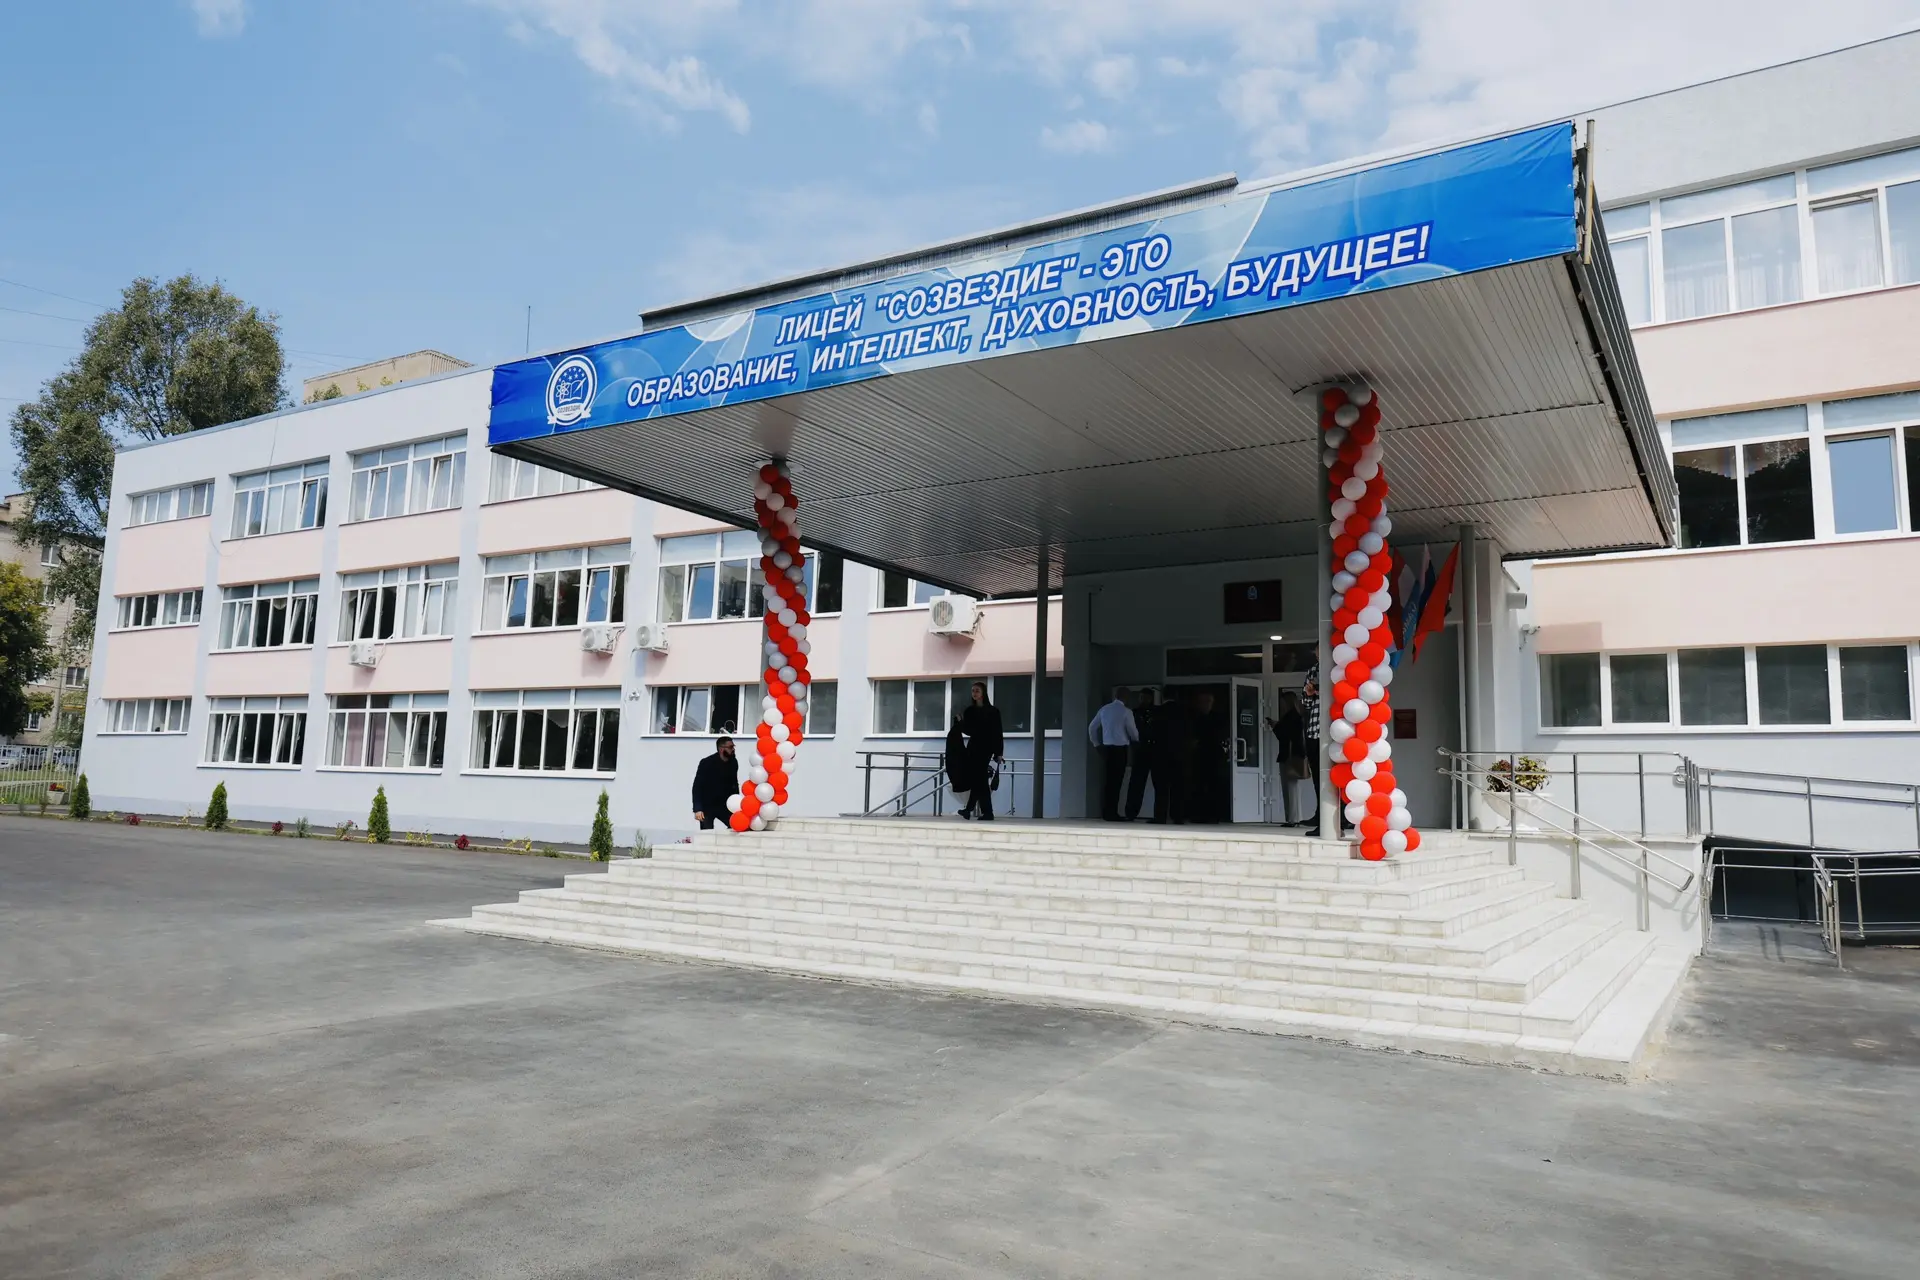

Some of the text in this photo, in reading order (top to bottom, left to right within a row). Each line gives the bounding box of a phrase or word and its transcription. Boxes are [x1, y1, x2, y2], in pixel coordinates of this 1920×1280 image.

[626, 225, 1431, 407] ОБРАЗОВАНИЕ, ИНТЕЛЛЕКТ, ДУХОВНОСТЬ, БУДУЩЕЕ!
[775, 298, 864, 345] ЛИЦЕЙ
[877, 255, 1078, 321] "СОЗВЕЗДИЕ"
[1101, 236, 1170, 278] ЭТО
